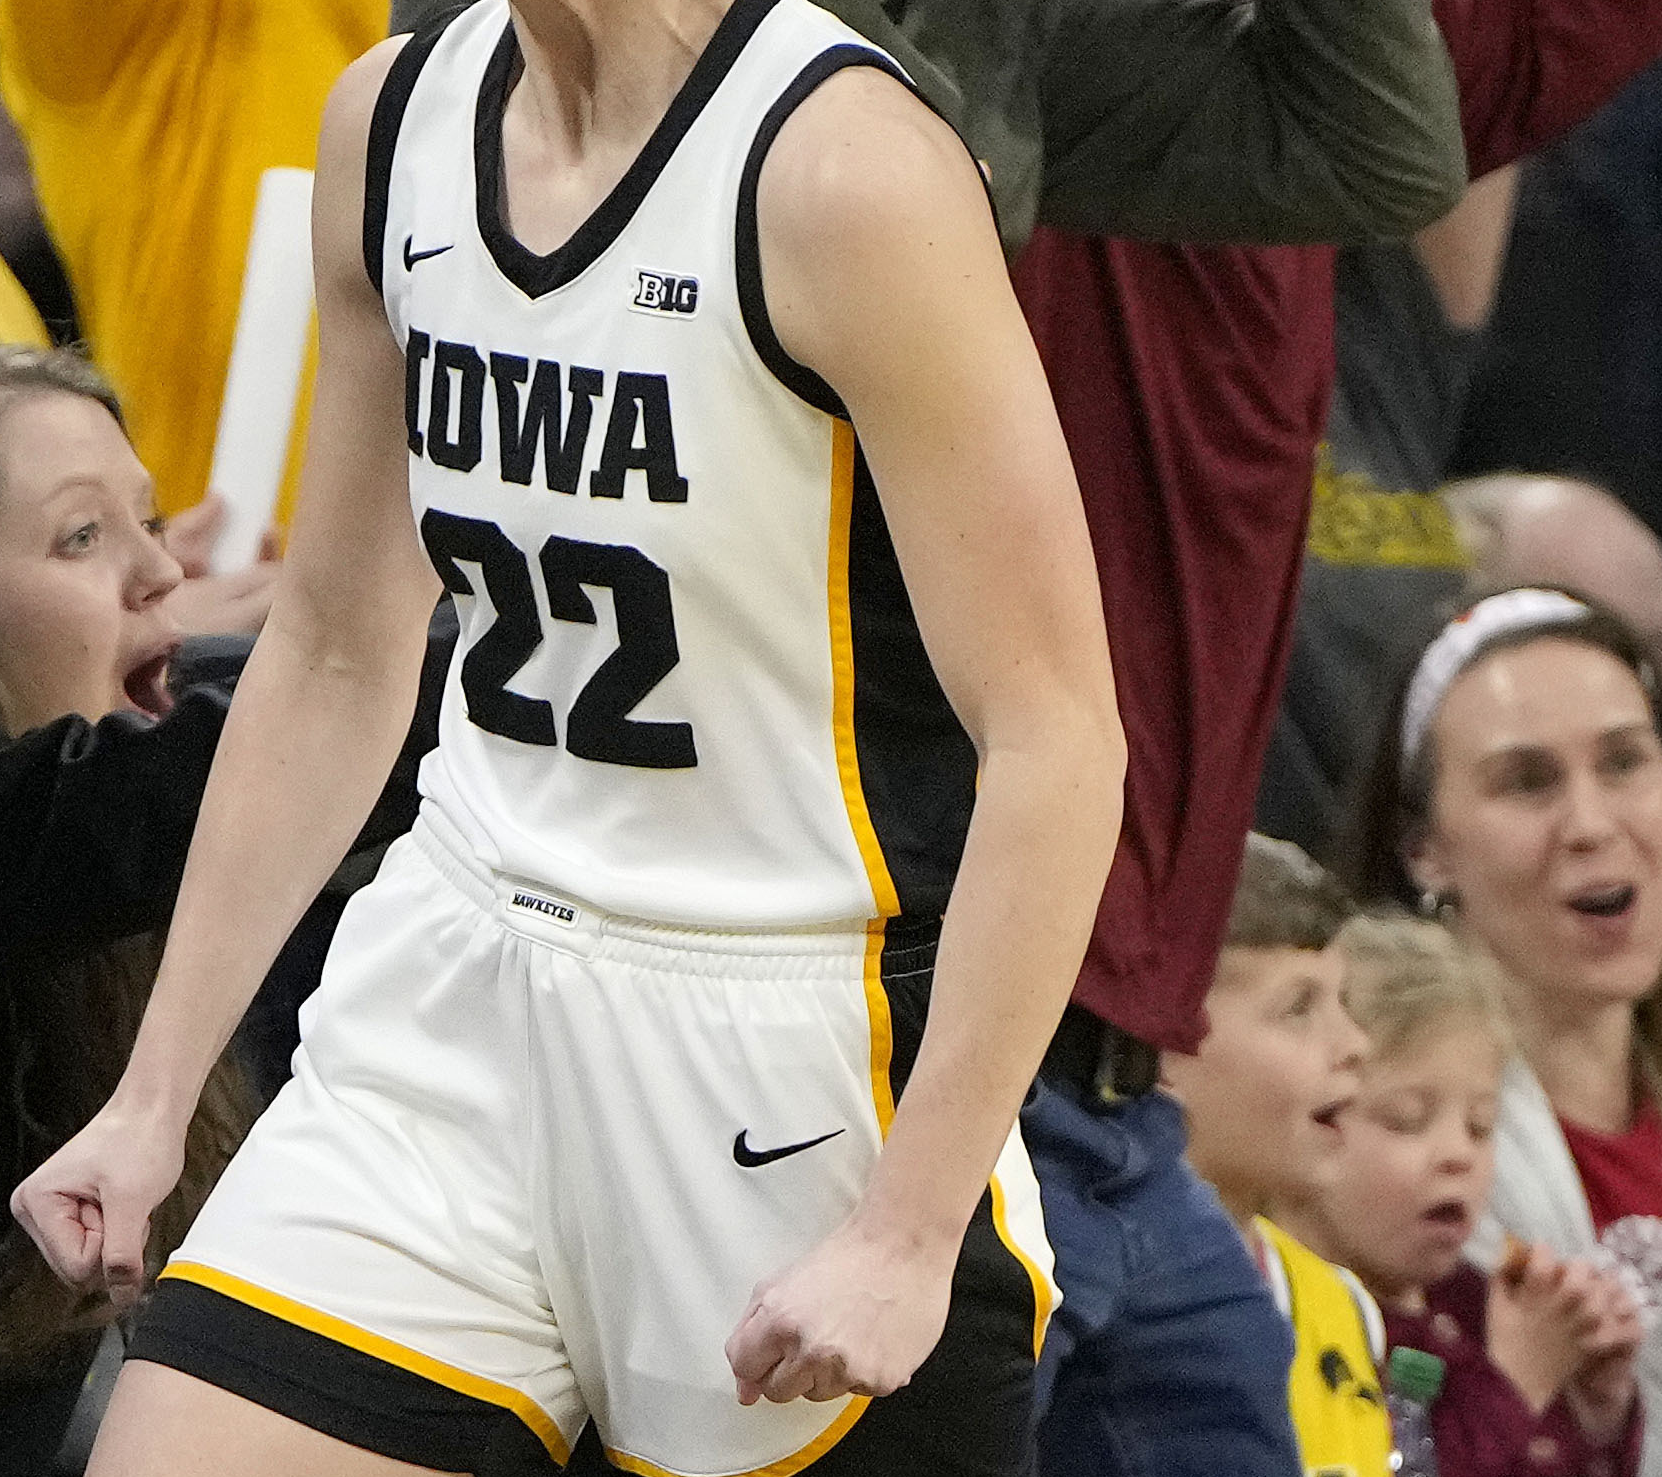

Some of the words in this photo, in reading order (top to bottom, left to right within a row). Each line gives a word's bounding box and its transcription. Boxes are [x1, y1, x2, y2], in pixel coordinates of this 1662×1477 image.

[404, 325, 689, 503] IOWA
[420, 507, 698, 768] 22
[512, 892, 575, 922] HAWKEYES
